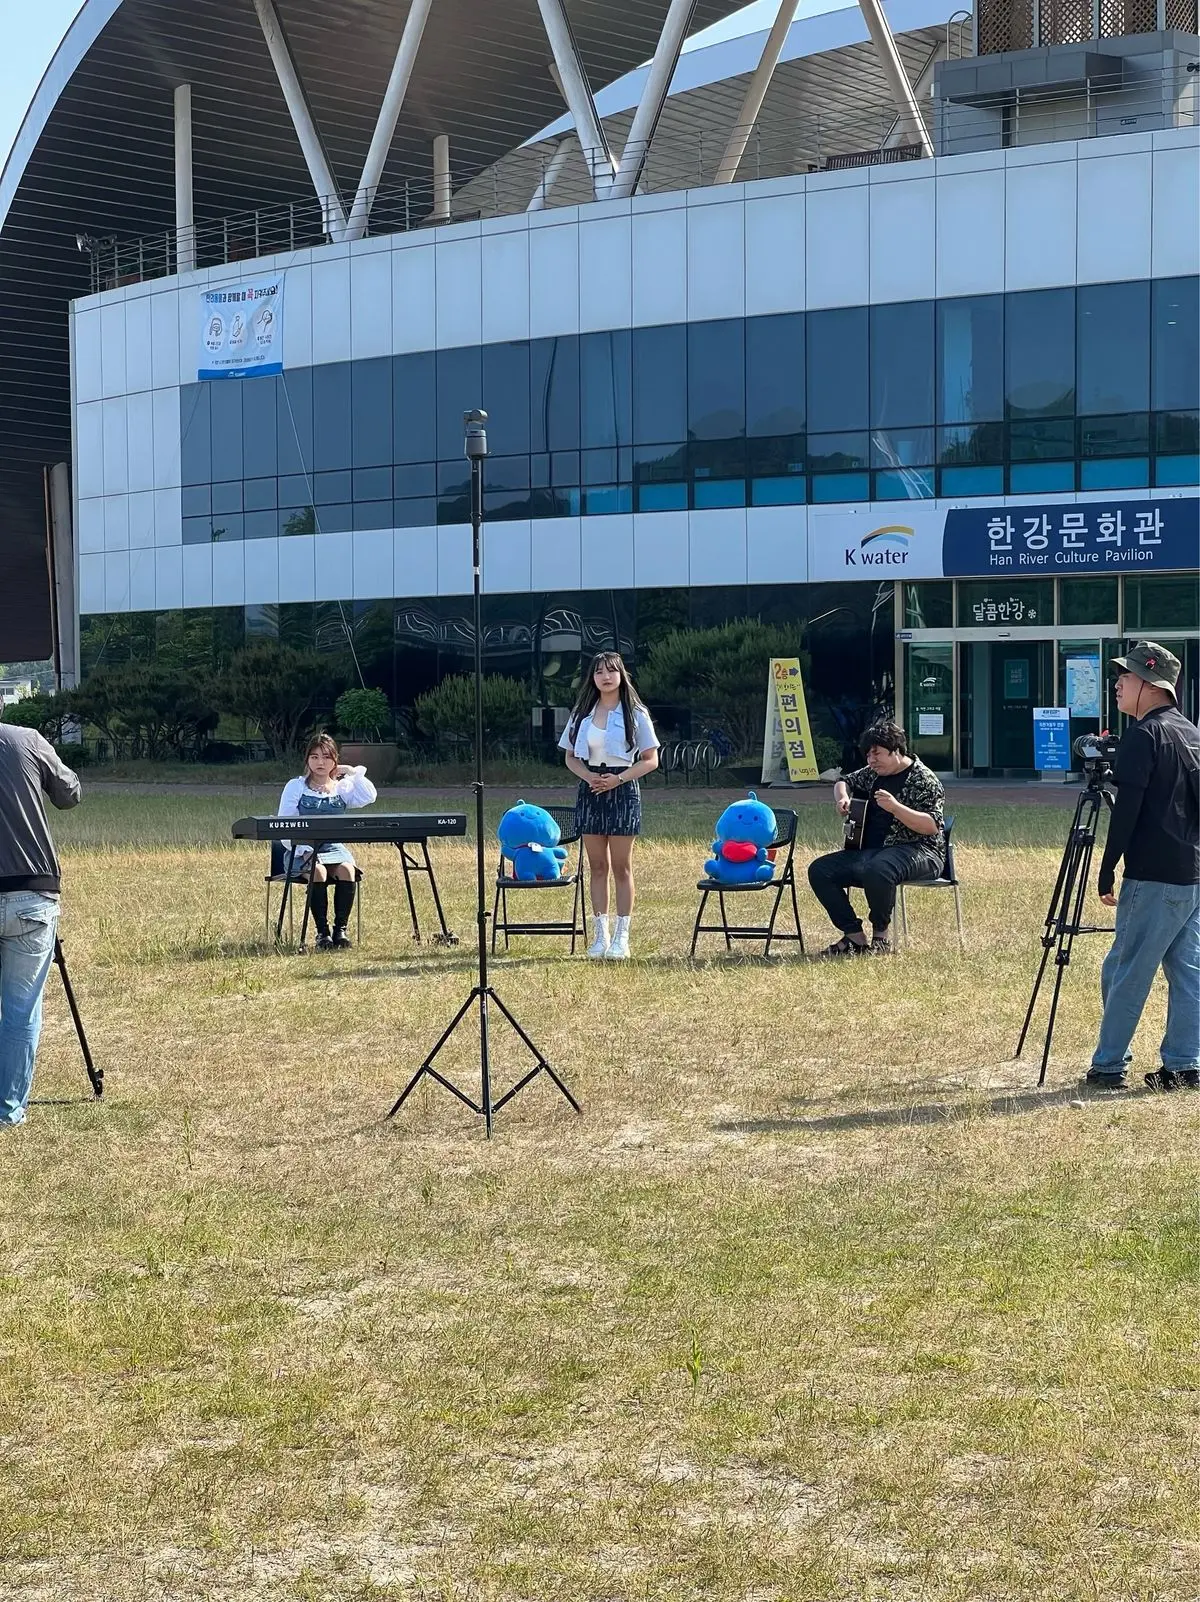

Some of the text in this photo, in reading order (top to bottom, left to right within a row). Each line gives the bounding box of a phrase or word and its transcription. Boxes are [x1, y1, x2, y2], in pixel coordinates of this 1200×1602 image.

[986, 508, 1165, 551] 한강문화관
[845, 548, 909, 566] K water
[990, 548, 1154, 567] Han River Culture Pavilion
[972, 601, 1026, 622] 달콤한강
[774, 663, 789, 680] 2층
[780, 693, 806, 759] 편의점
[269, 818, 457, 829] KURZWEIL KA-120
